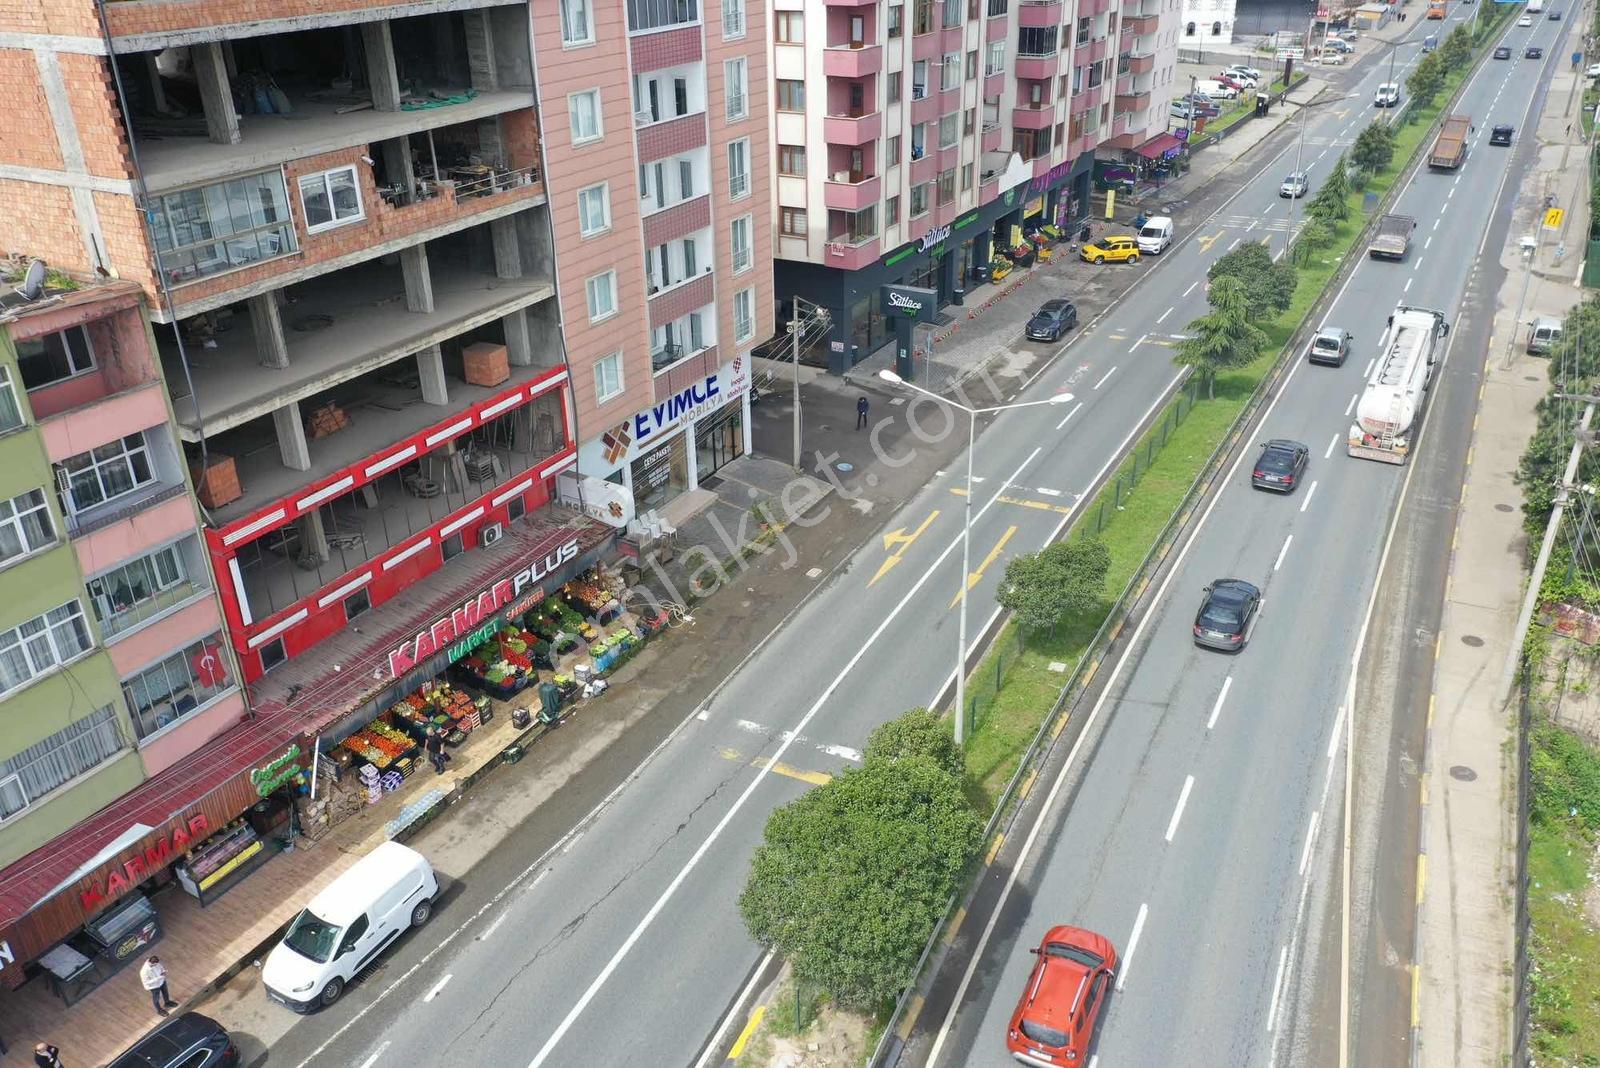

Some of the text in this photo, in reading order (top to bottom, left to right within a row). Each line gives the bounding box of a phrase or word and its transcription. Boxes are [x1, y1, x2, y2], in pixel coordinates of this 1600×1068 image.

[389, 538, 580, 678] KARMAR PLUS
[448, 617, 500, 664] MARKET
[80, 813, 209, 911] KARMAR
